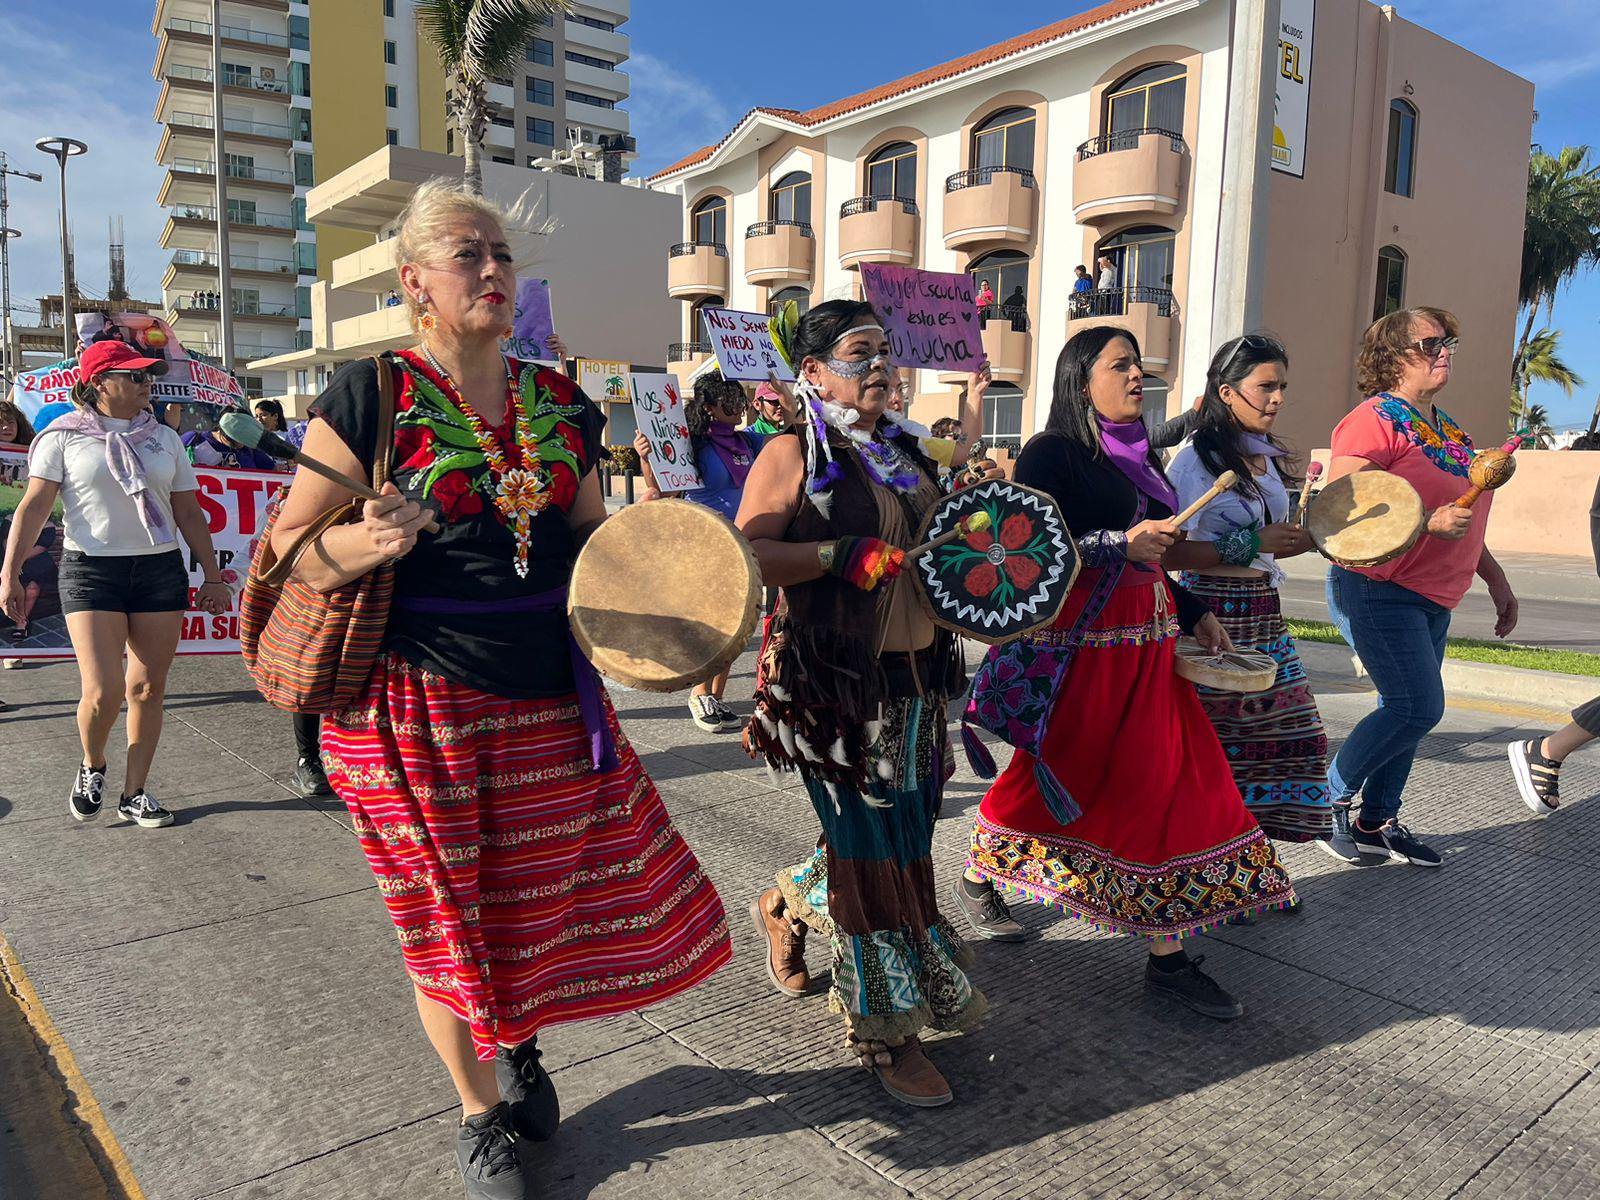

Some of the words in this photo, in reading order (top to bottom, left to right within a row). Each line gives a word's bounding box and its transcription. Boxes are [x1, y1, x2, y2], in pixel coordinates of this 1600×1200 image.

[1278, 39, 1304, 85] EL
[865, 267, 918, 309] Mujer
[917, 270, 974, 305] Escucha
[739, 314, 769, 334] SEMB
[720, 333, 755, 351] MIEDO
[758, 338, 778, 352] NO
[23, 375, 36, 392] 2
[40, 367, 81, 391] AÑO
[584, 361, 624, 376] HOTEL
[43, 391, 68, 403] DE
[151, 384, 190, 396] RLETTE
[652, 440, 676, 464] NO
[180, 616, 206, 640] RA
